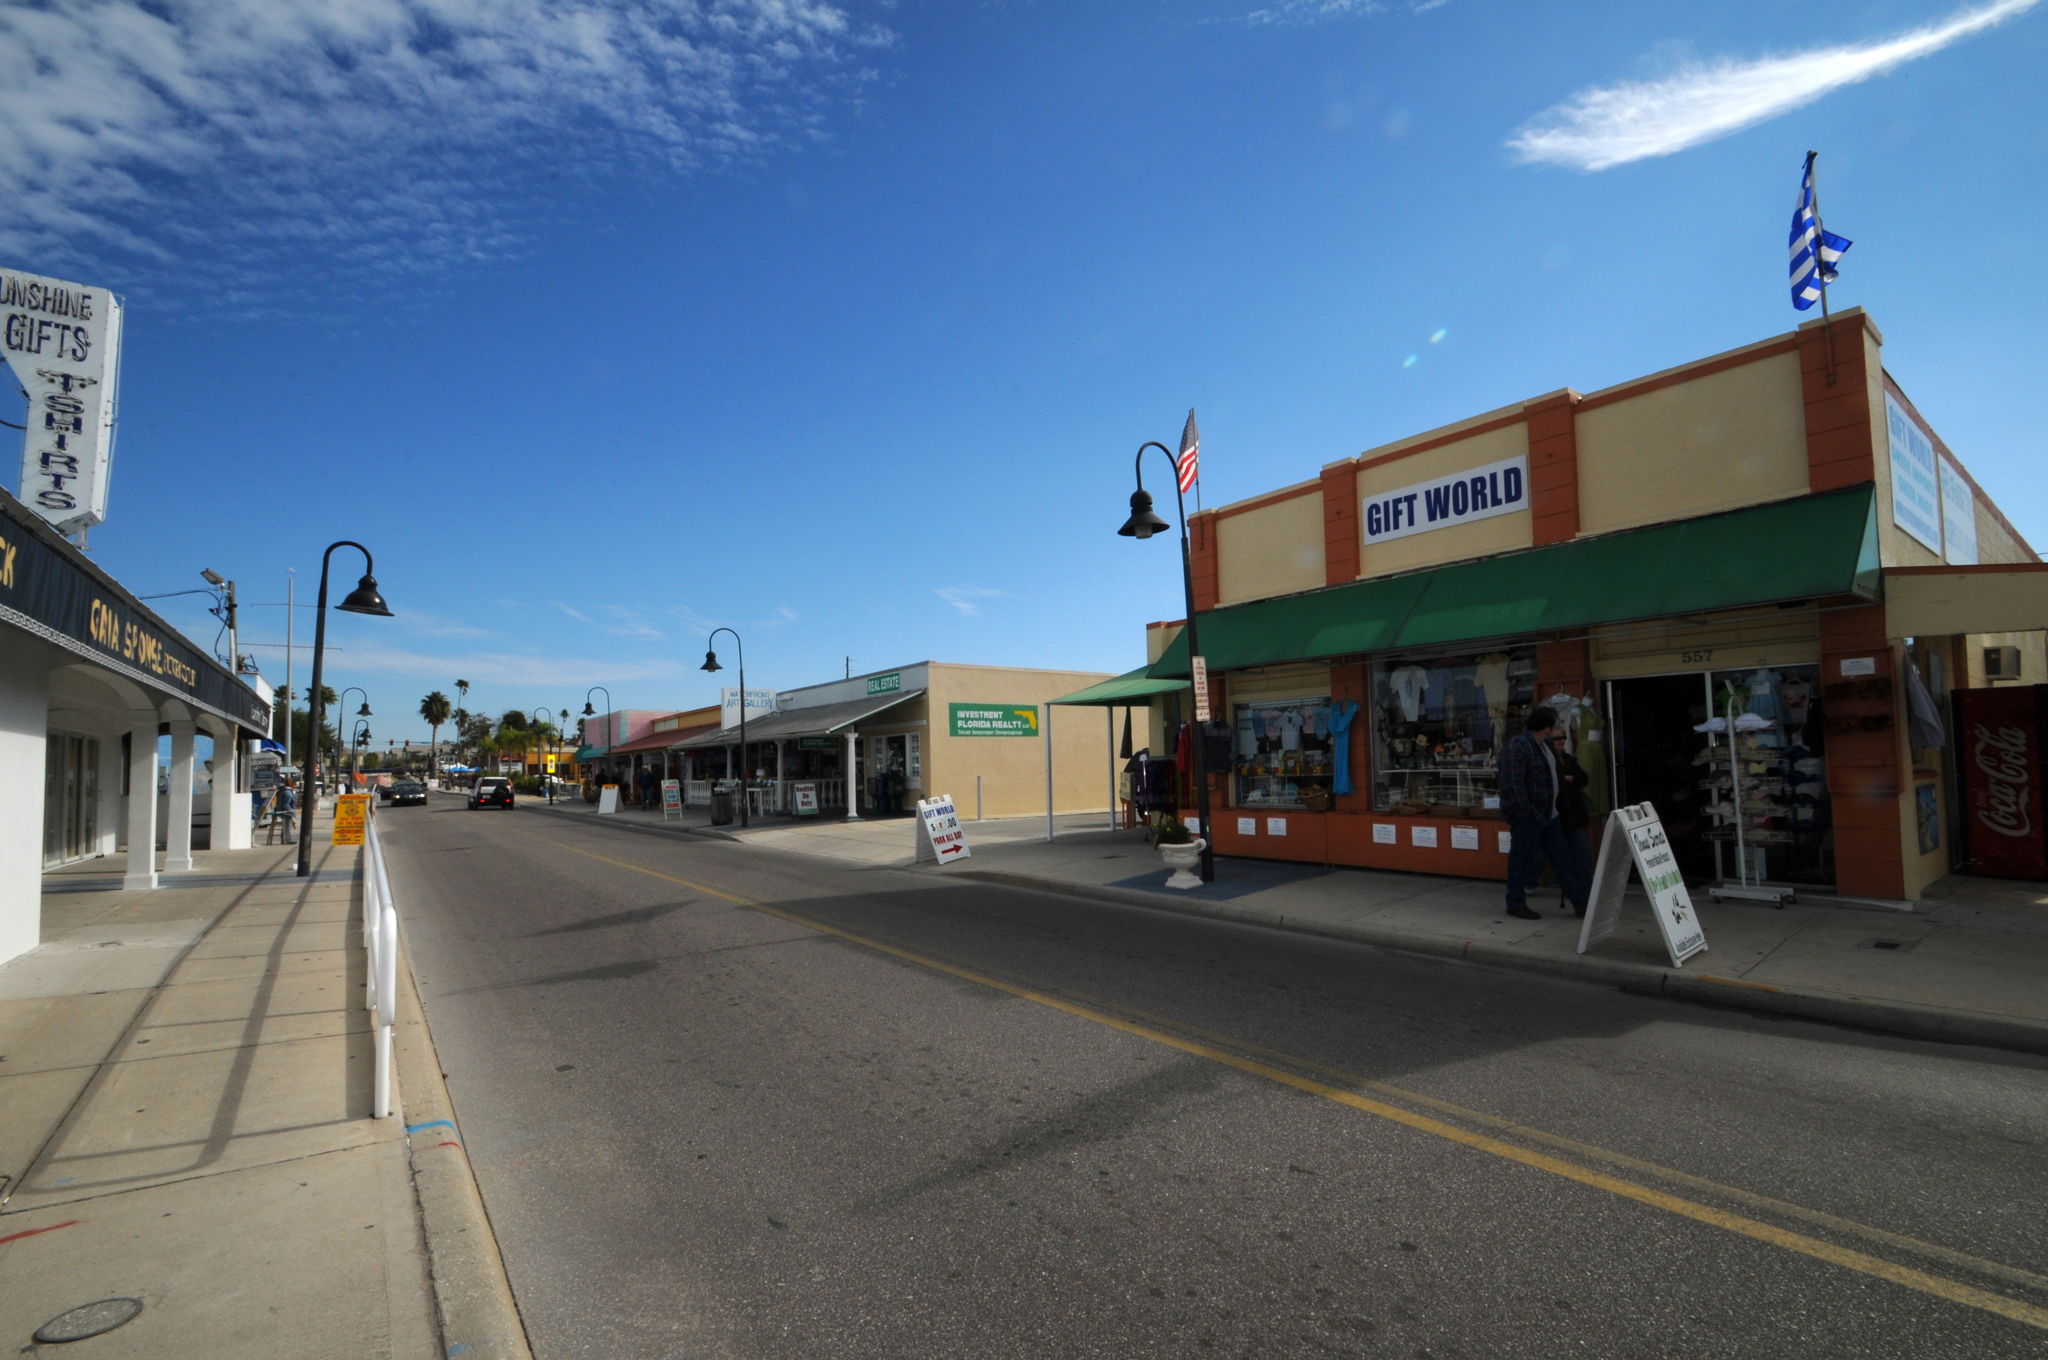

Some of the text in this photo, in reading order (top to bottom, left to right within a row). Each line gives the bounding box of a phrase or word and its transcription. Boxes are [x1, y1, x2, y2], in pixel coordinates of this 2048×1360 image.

[6, 313, 90, 363] GIFTS
[1367, 466, 1523, 536] GIFT WORLD
[90, 598, 120, 653] GAIA
[1681, 649, 1713, 664] 557
[868, 675, 900, 692] REAL ESTATE
[727, 698, 740, 709] ART
[957, 710, 1003, 719] INVESTMENT
[957, 720, 991, 728] FLORIDA
[992, 721, 1021, 729] REALTY
[1974, 722, 2030, 837] Coca-Cola
[924, 804, 954, 819] GIFT WORLD
